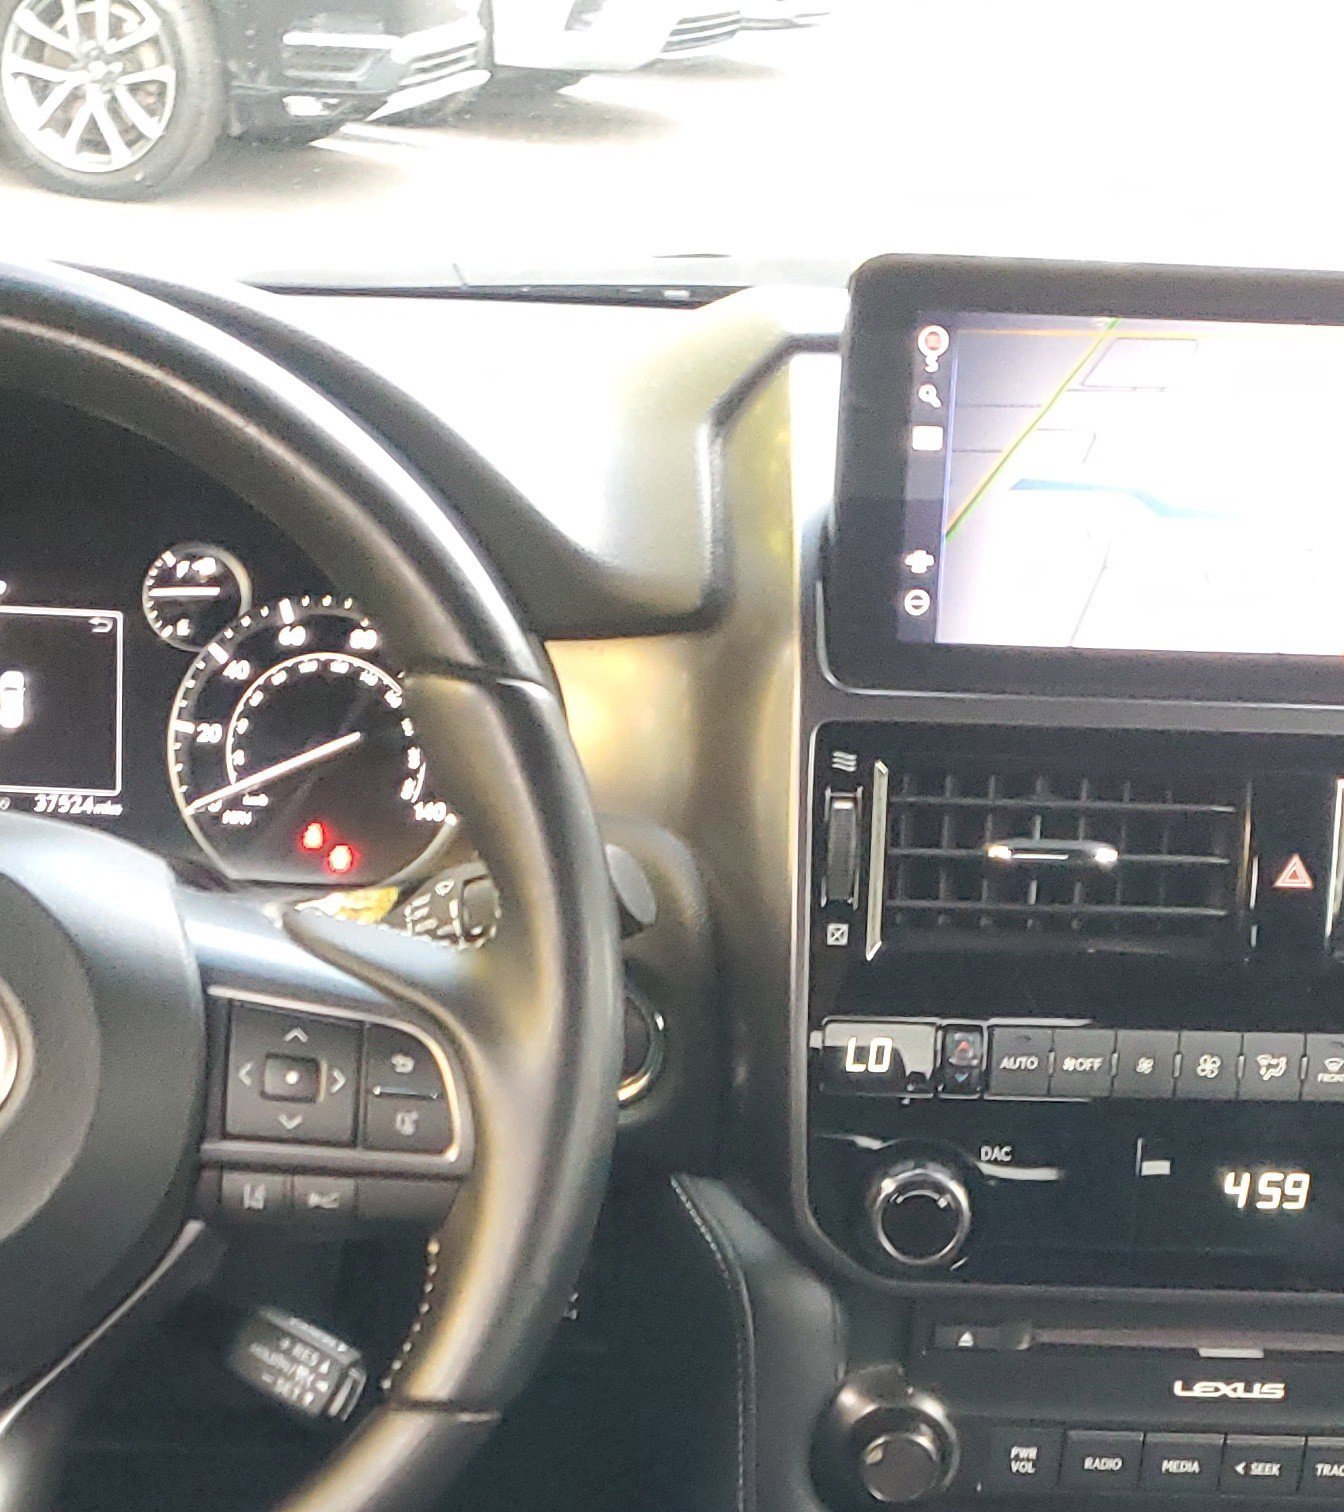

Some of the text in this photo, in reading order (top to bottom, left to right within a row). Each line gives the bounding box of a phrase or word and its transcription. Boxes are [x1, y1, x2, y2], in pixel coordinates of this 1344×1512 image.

[222, 659, 250, 680] 40
[196, 722, 222, 743] 20
[413, 802, 447, 821] 140
[1000, 1055, 1039, 1071] AUTO
[980, 1145, 1012, 1163] DAC
[1174, 1380, 1285, 1400] LEXUS
[1010, 1446, 1038, 1461] PWR
[1011, 1459, 1037, 1474] VOL
[1084, 1457, 1123, 1471] RADIO
[1161, 1459, 1201, 1474] MEDIA
[1249, 1463, 1281, 1476] SEEK
